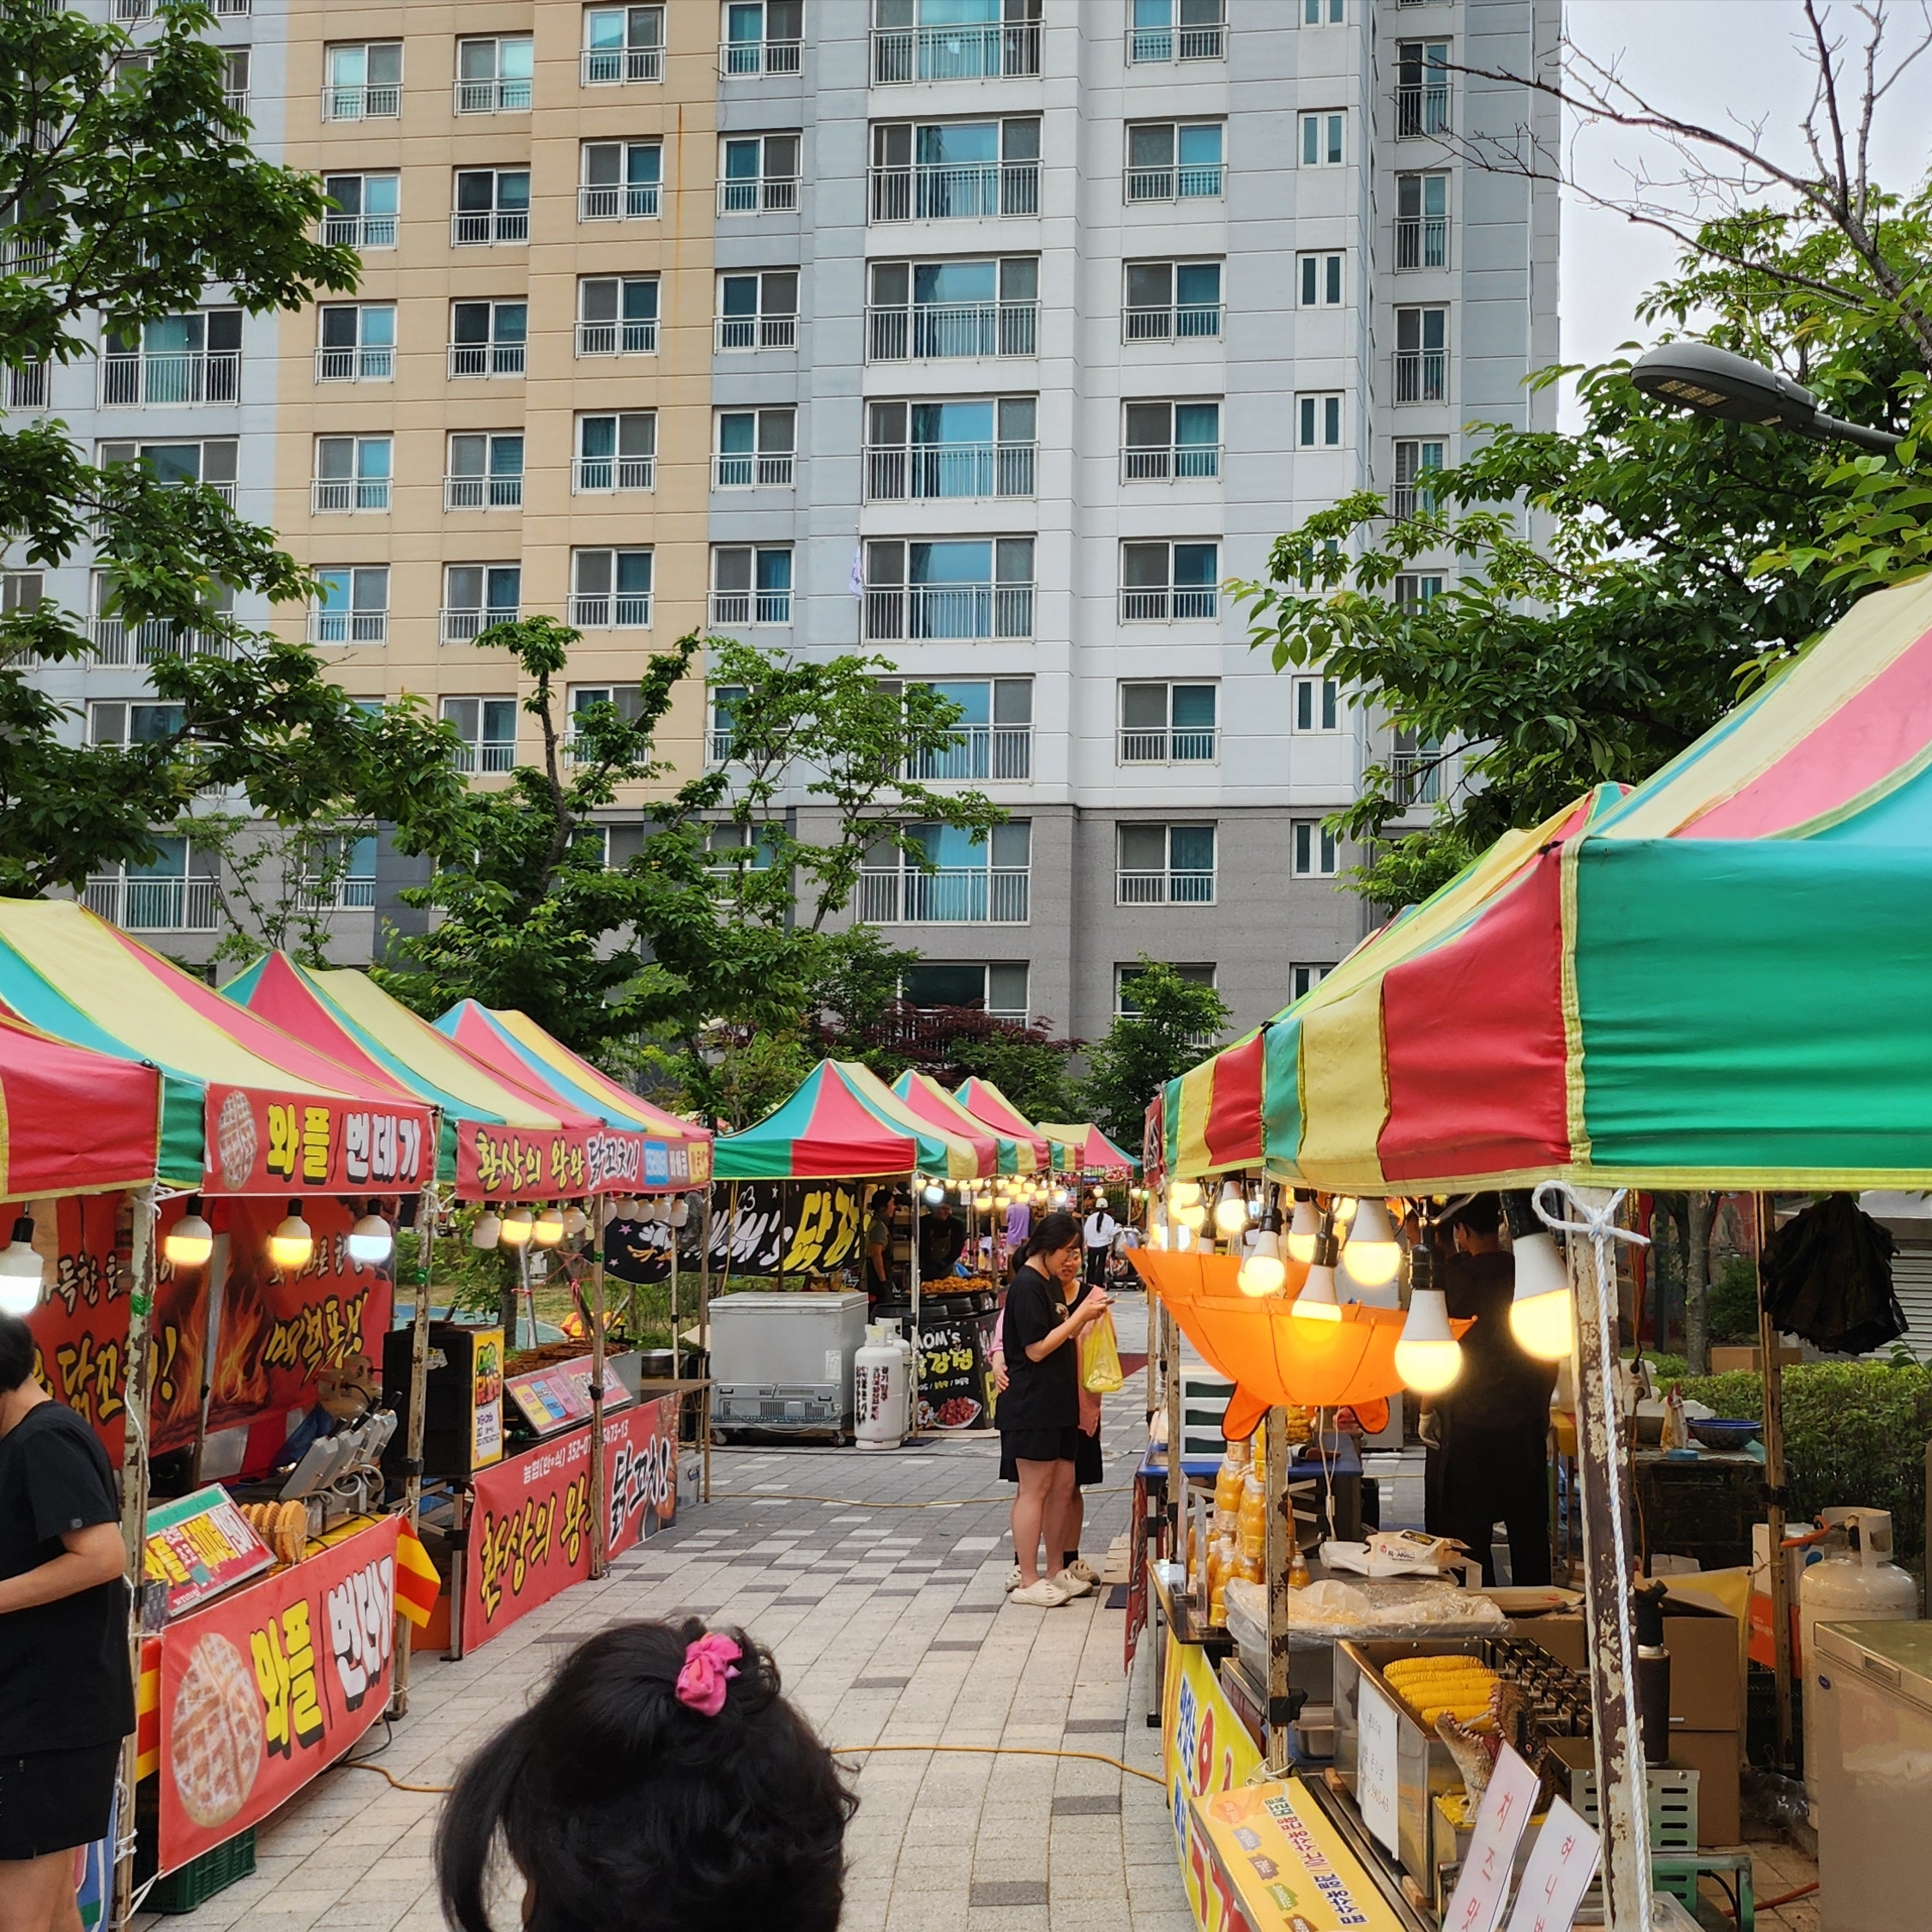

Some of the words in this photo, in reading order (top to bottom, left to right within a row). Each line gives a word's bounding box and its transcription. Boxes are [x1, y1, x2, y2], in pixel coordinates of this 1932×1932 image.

[267, 1103, 331, 1185] 와플
[345, 1112, 420, 1185] 번데기
[474, 1129, 543, 1195] 환상의
[550, 1138, 584, 1192] 왕왕
[587, 1131, 640, 1191] 닭꼬치!
[770, 1186, 872, 1272] 닭강
[480, 1491, 558, 1624] 환상의
[560, 1470, 595, 1568] 왕
[608, 1432, 673, 1552] 닭꼬치!
[250, 1598, 325, 1761] 와플
[327, 1555, 395, 1713] 번데기
[1287, 1830, 1318, 1851] 옥수수
[1324, 1890, 1361, 1915] 옥수수
